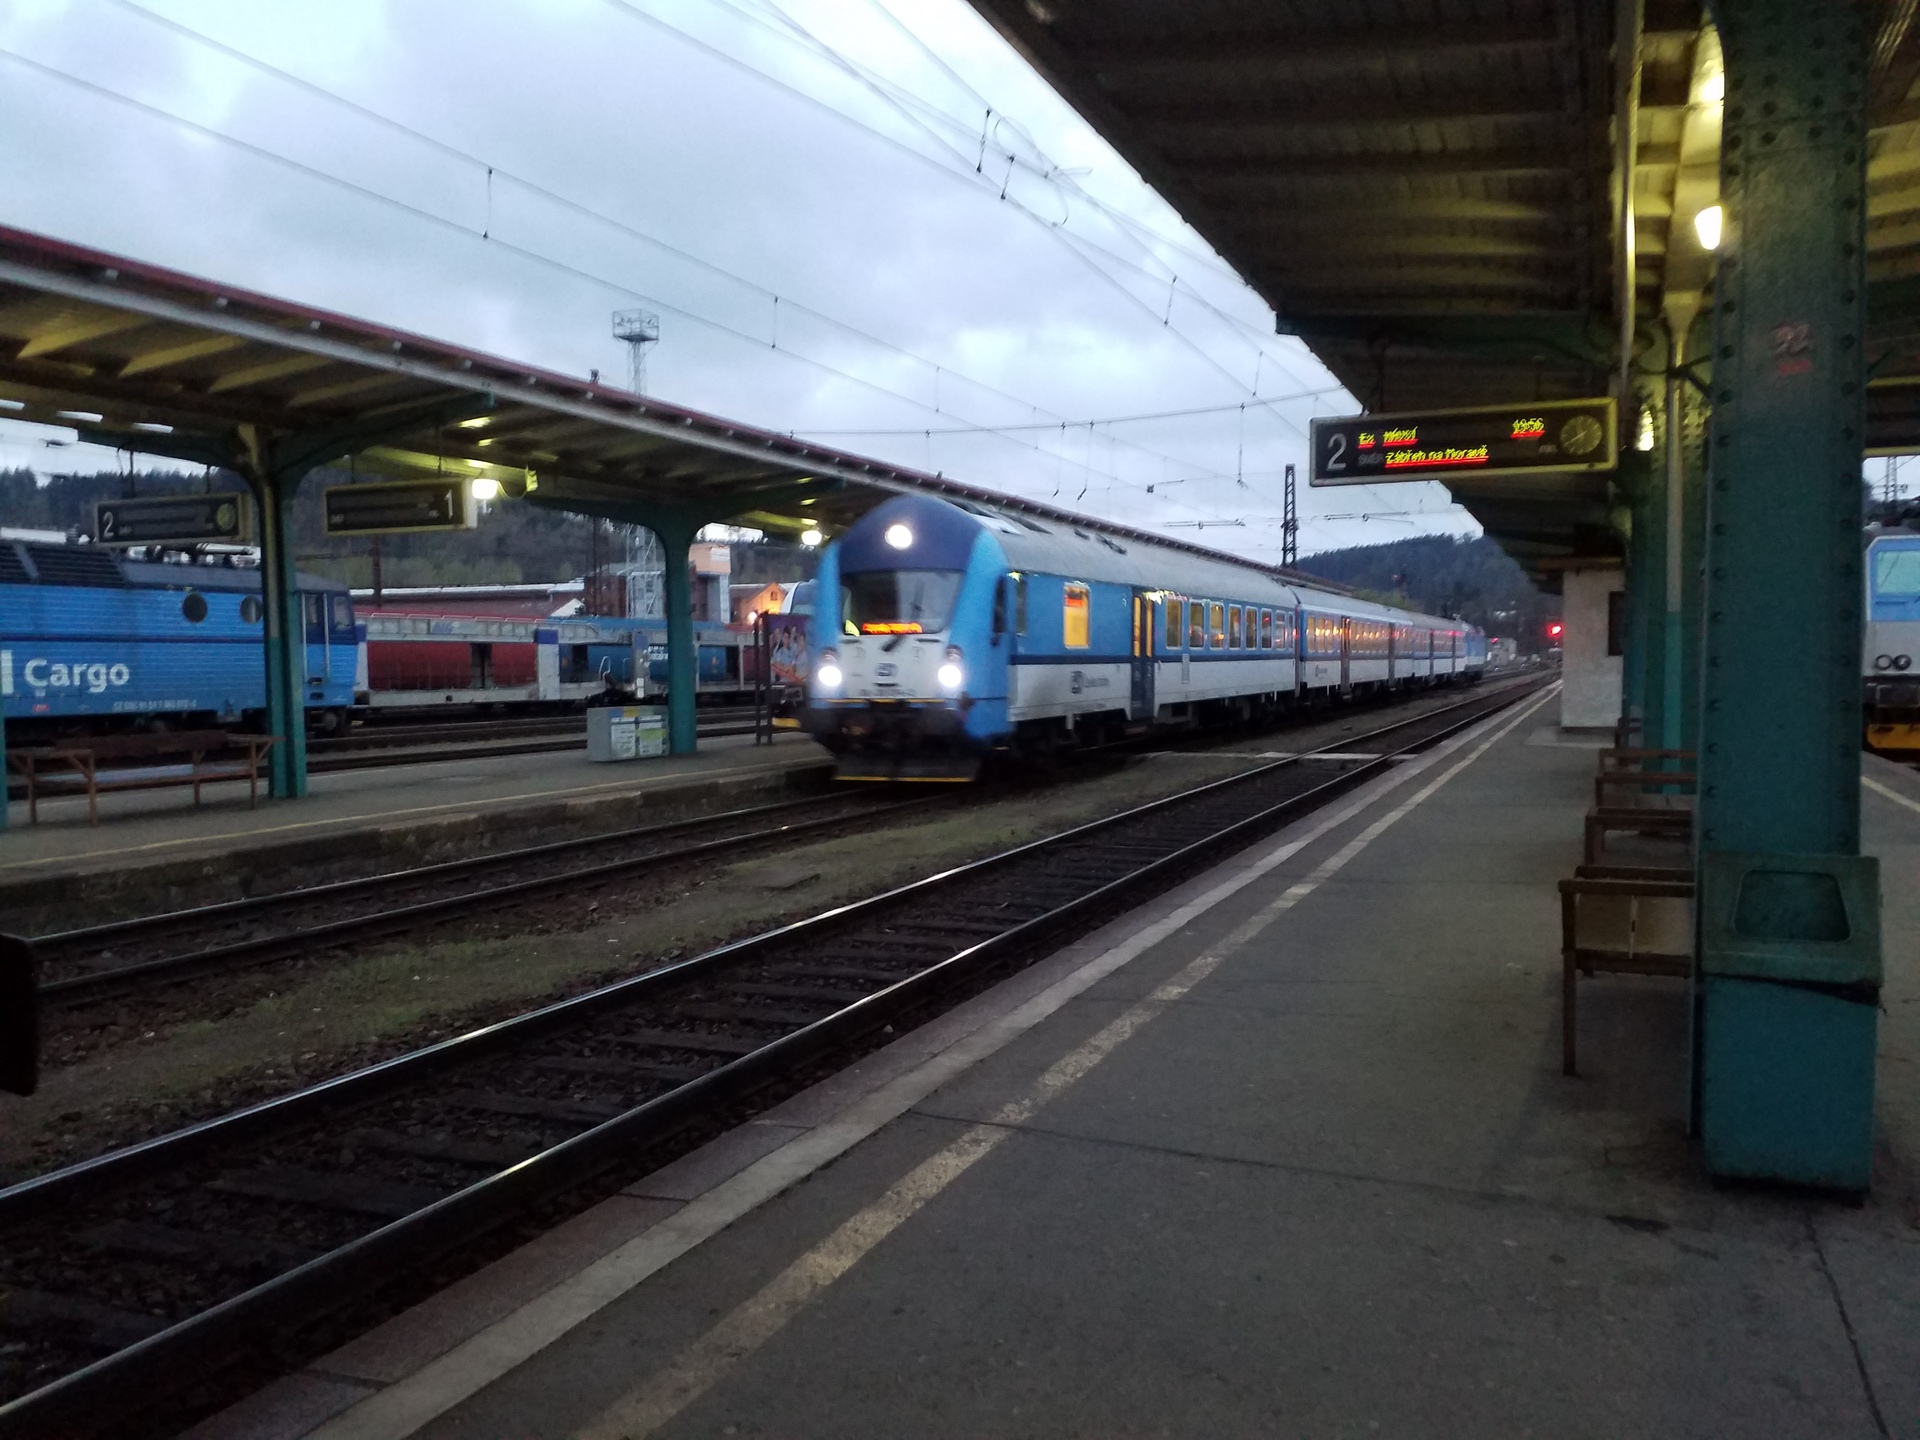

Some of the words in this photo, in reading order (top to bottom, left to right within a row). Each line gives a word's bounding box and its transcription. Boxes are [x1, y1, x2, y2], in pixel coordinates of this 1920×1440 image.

[1326, 432, 1347, 472] 2
[444, 489, 453, 519] 1
[103, 511, 114, 539] 2
[24, 658, 130, 693] Cargo
